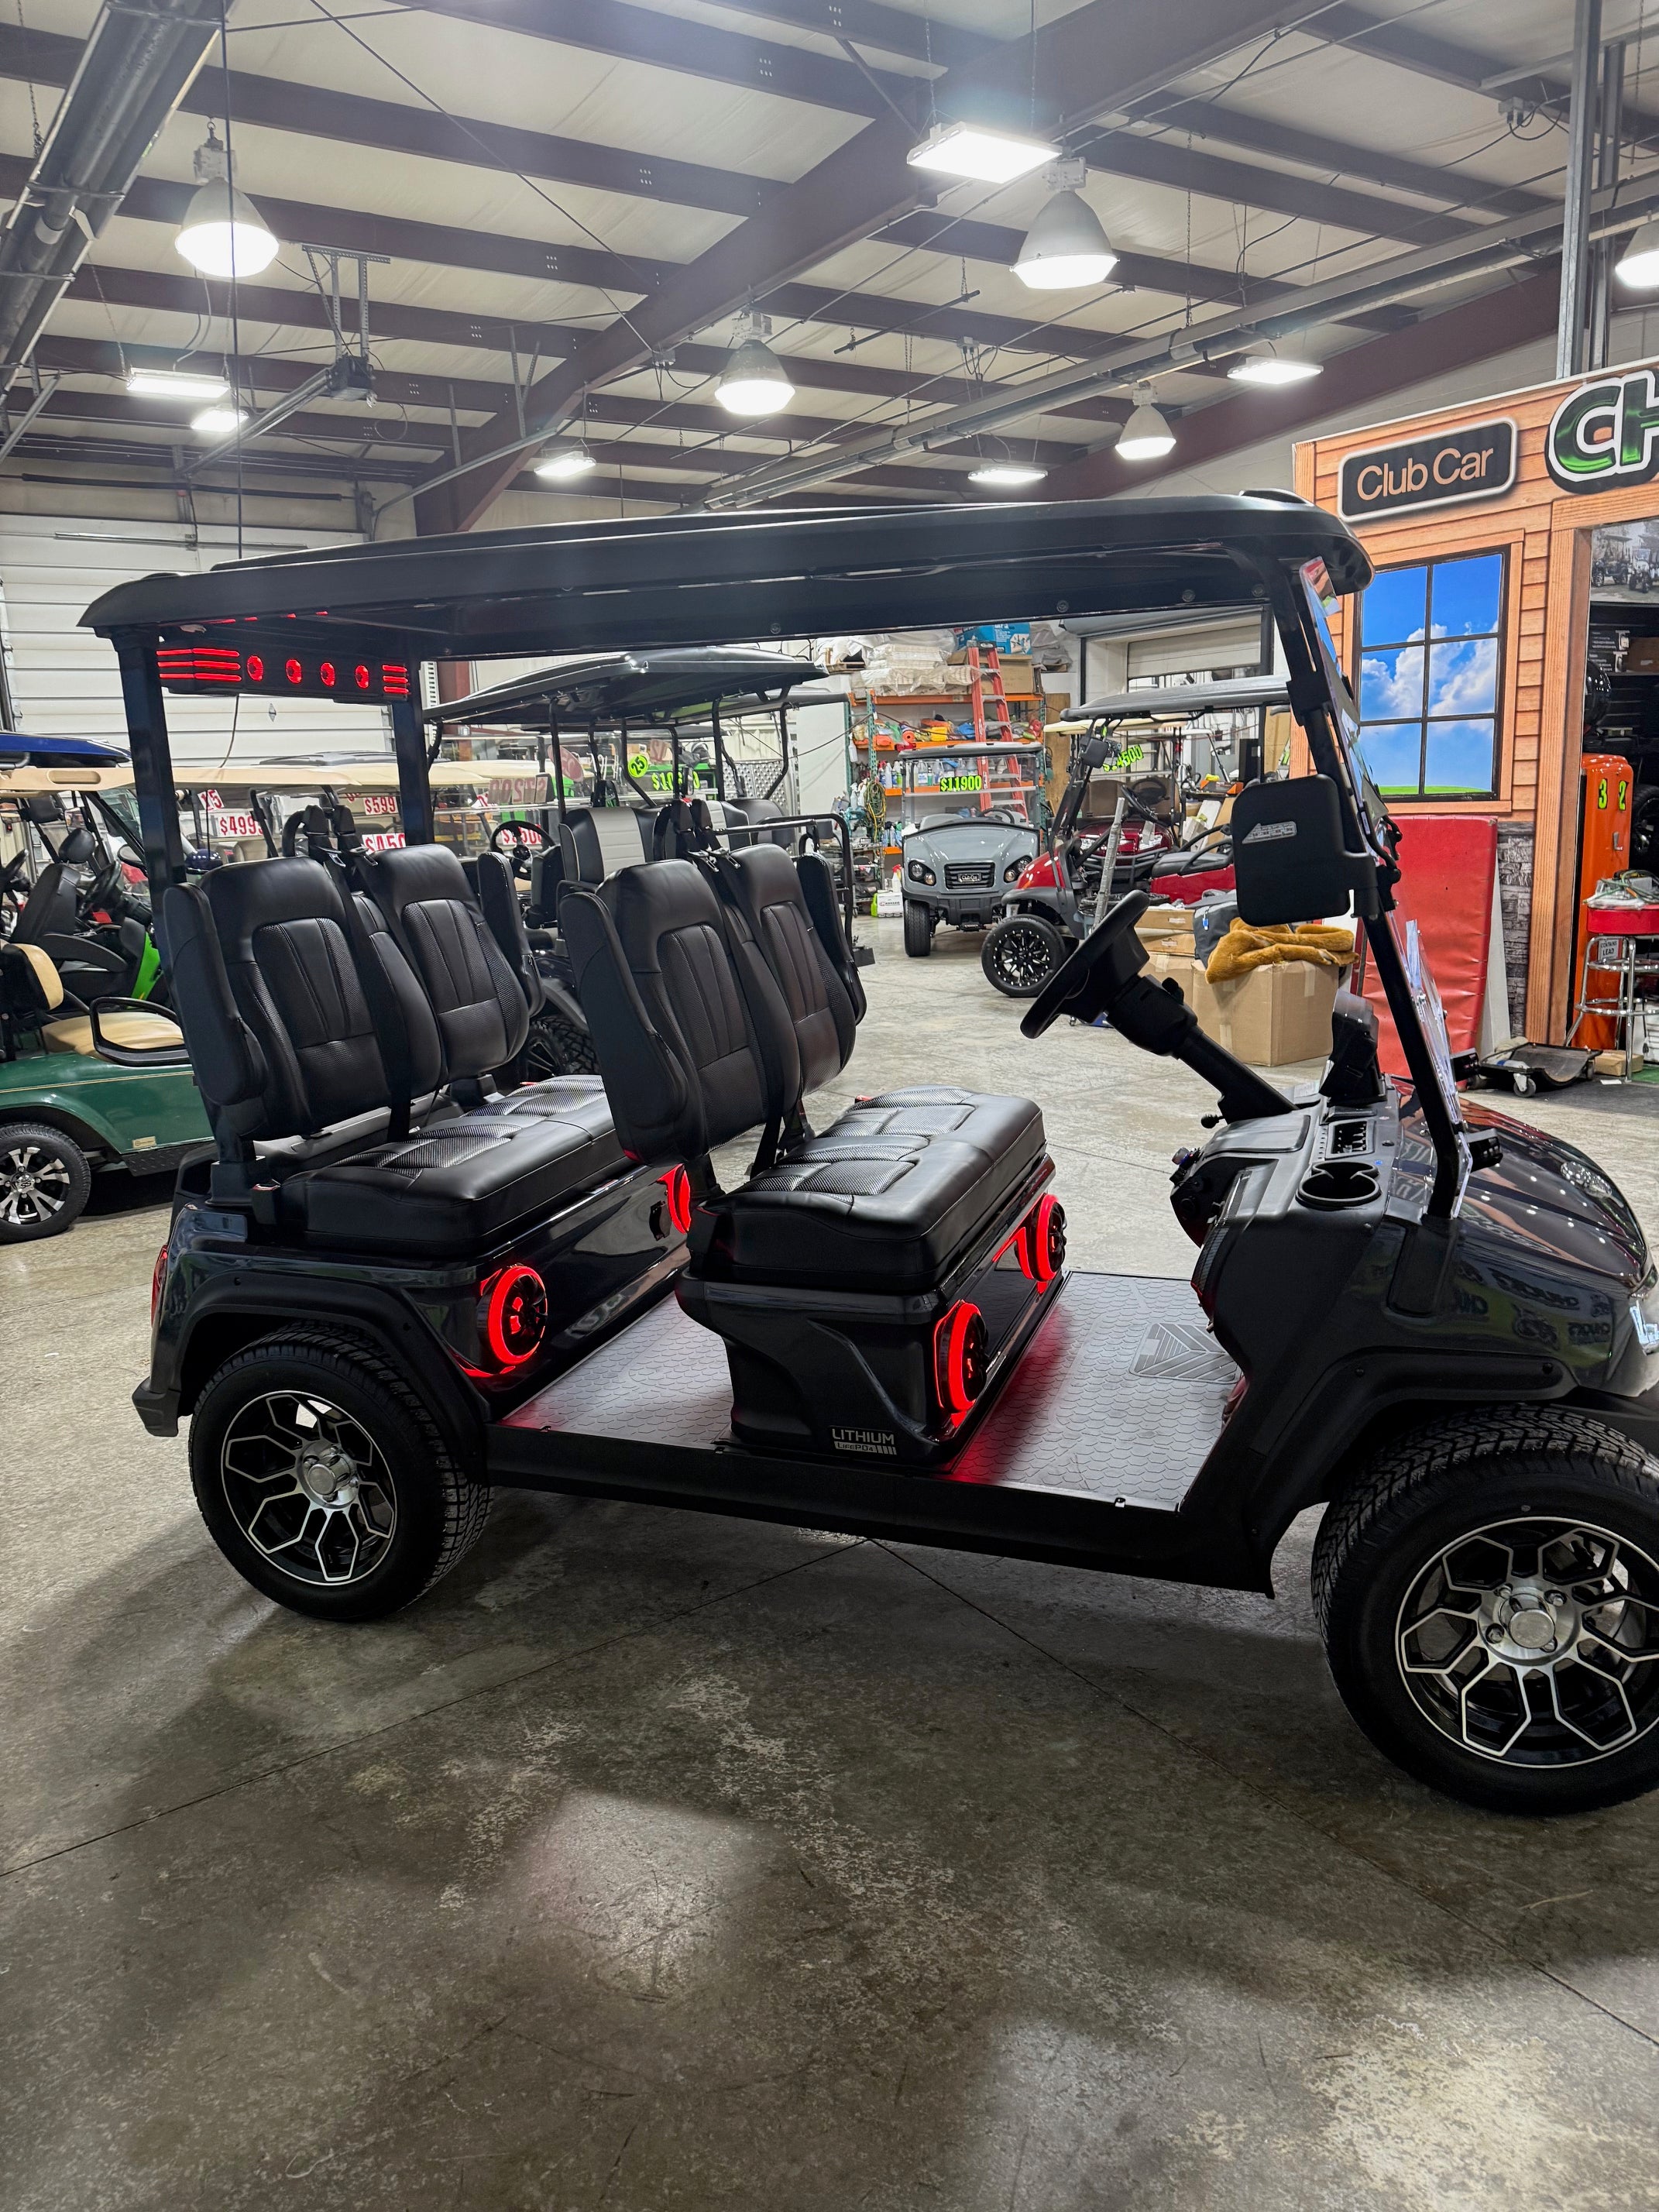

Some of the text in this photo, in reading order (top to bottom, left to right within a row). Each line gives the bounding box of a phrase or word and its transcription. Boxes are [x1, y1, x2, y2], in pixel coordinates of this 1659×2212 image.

[1358, 448, 1493, 500] Club Car
[631, 756, 645, 775] 25
[651, 771, 700, 791] $100
[940, 775, 982, 792] $11900
[1599, 778, 1626, 811] 3 2
[365, 796, 396, 813] $599
[220, 815, 263, 836] $499
[1602, 947, 1615, 956] LEAD
[832, 1428, 895, 1444] LITHIUM
